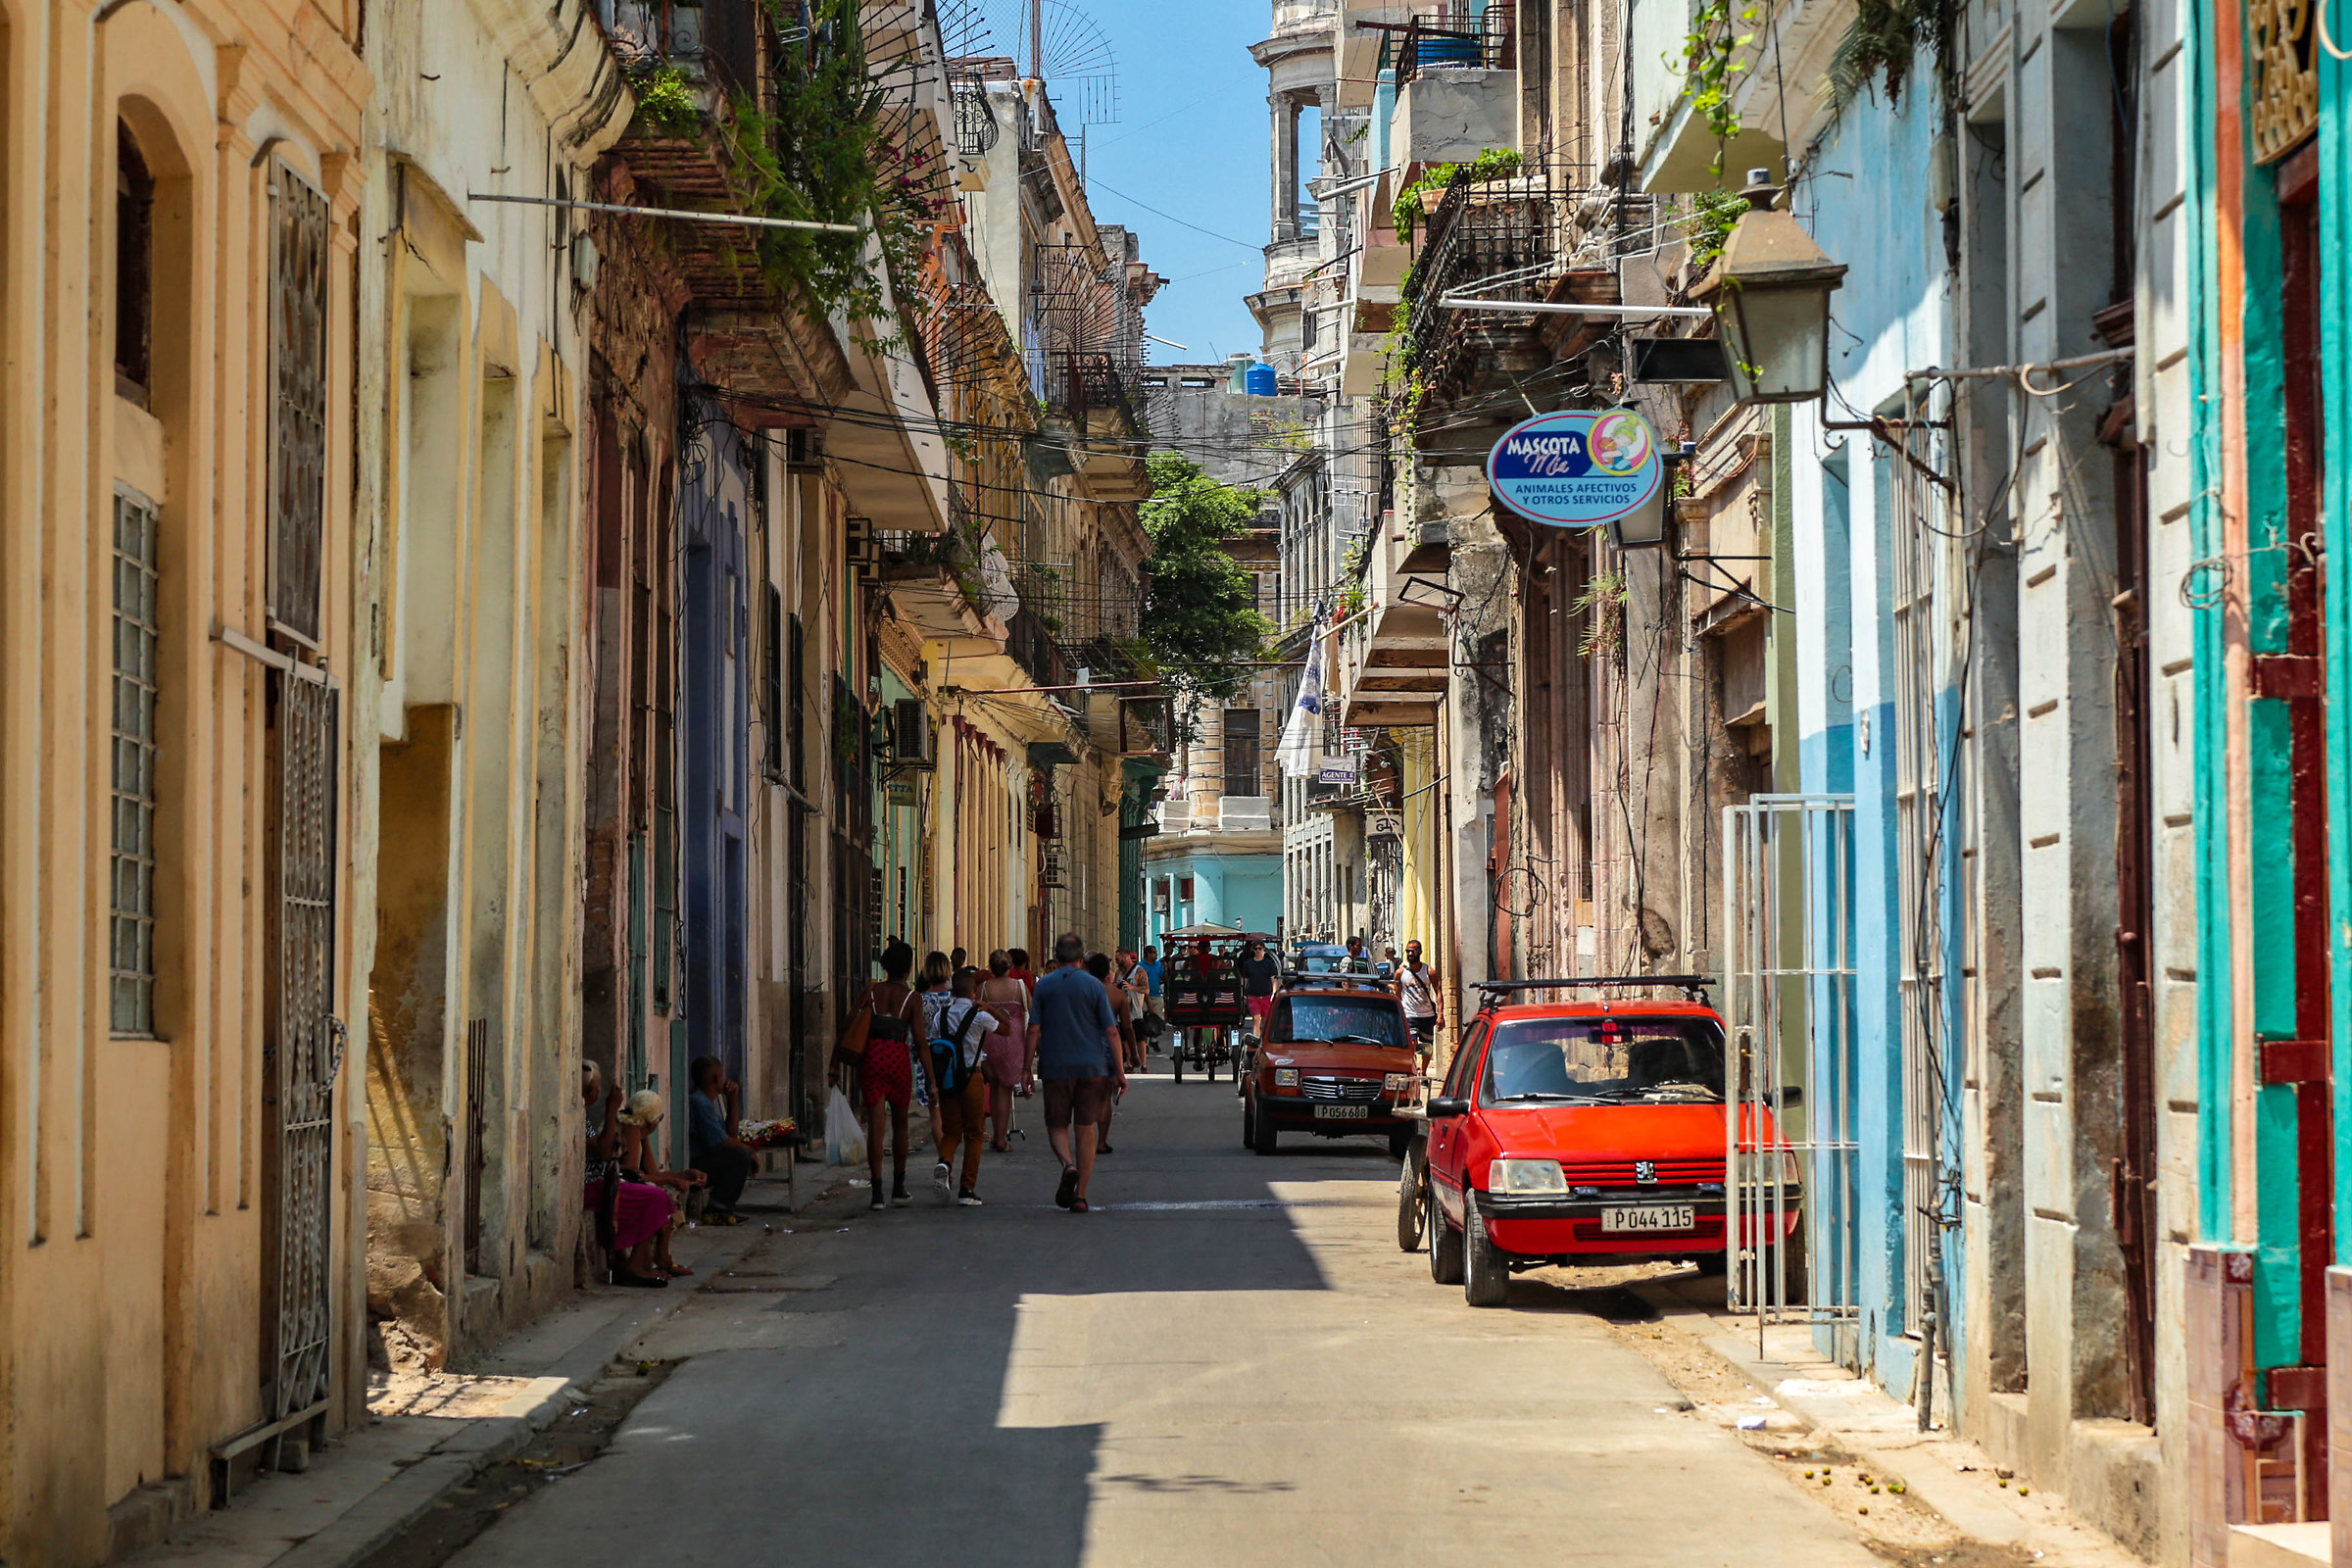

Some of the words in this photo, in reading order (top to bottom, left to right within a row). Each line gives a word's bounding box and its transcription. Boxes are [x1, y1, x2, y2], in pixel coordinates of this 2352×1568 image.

[1506, 437, 1581, 455] MASCOTA
[1515, 484, 1574, 494] ANIMALES
[1576, 483, 1638, 493] AFECTIVOS
[1523, 496, 1529, 505] Y
[1532, 495, 1570, 505] OTROS
[1573, 494, 1630, 505] SERVICIOS
